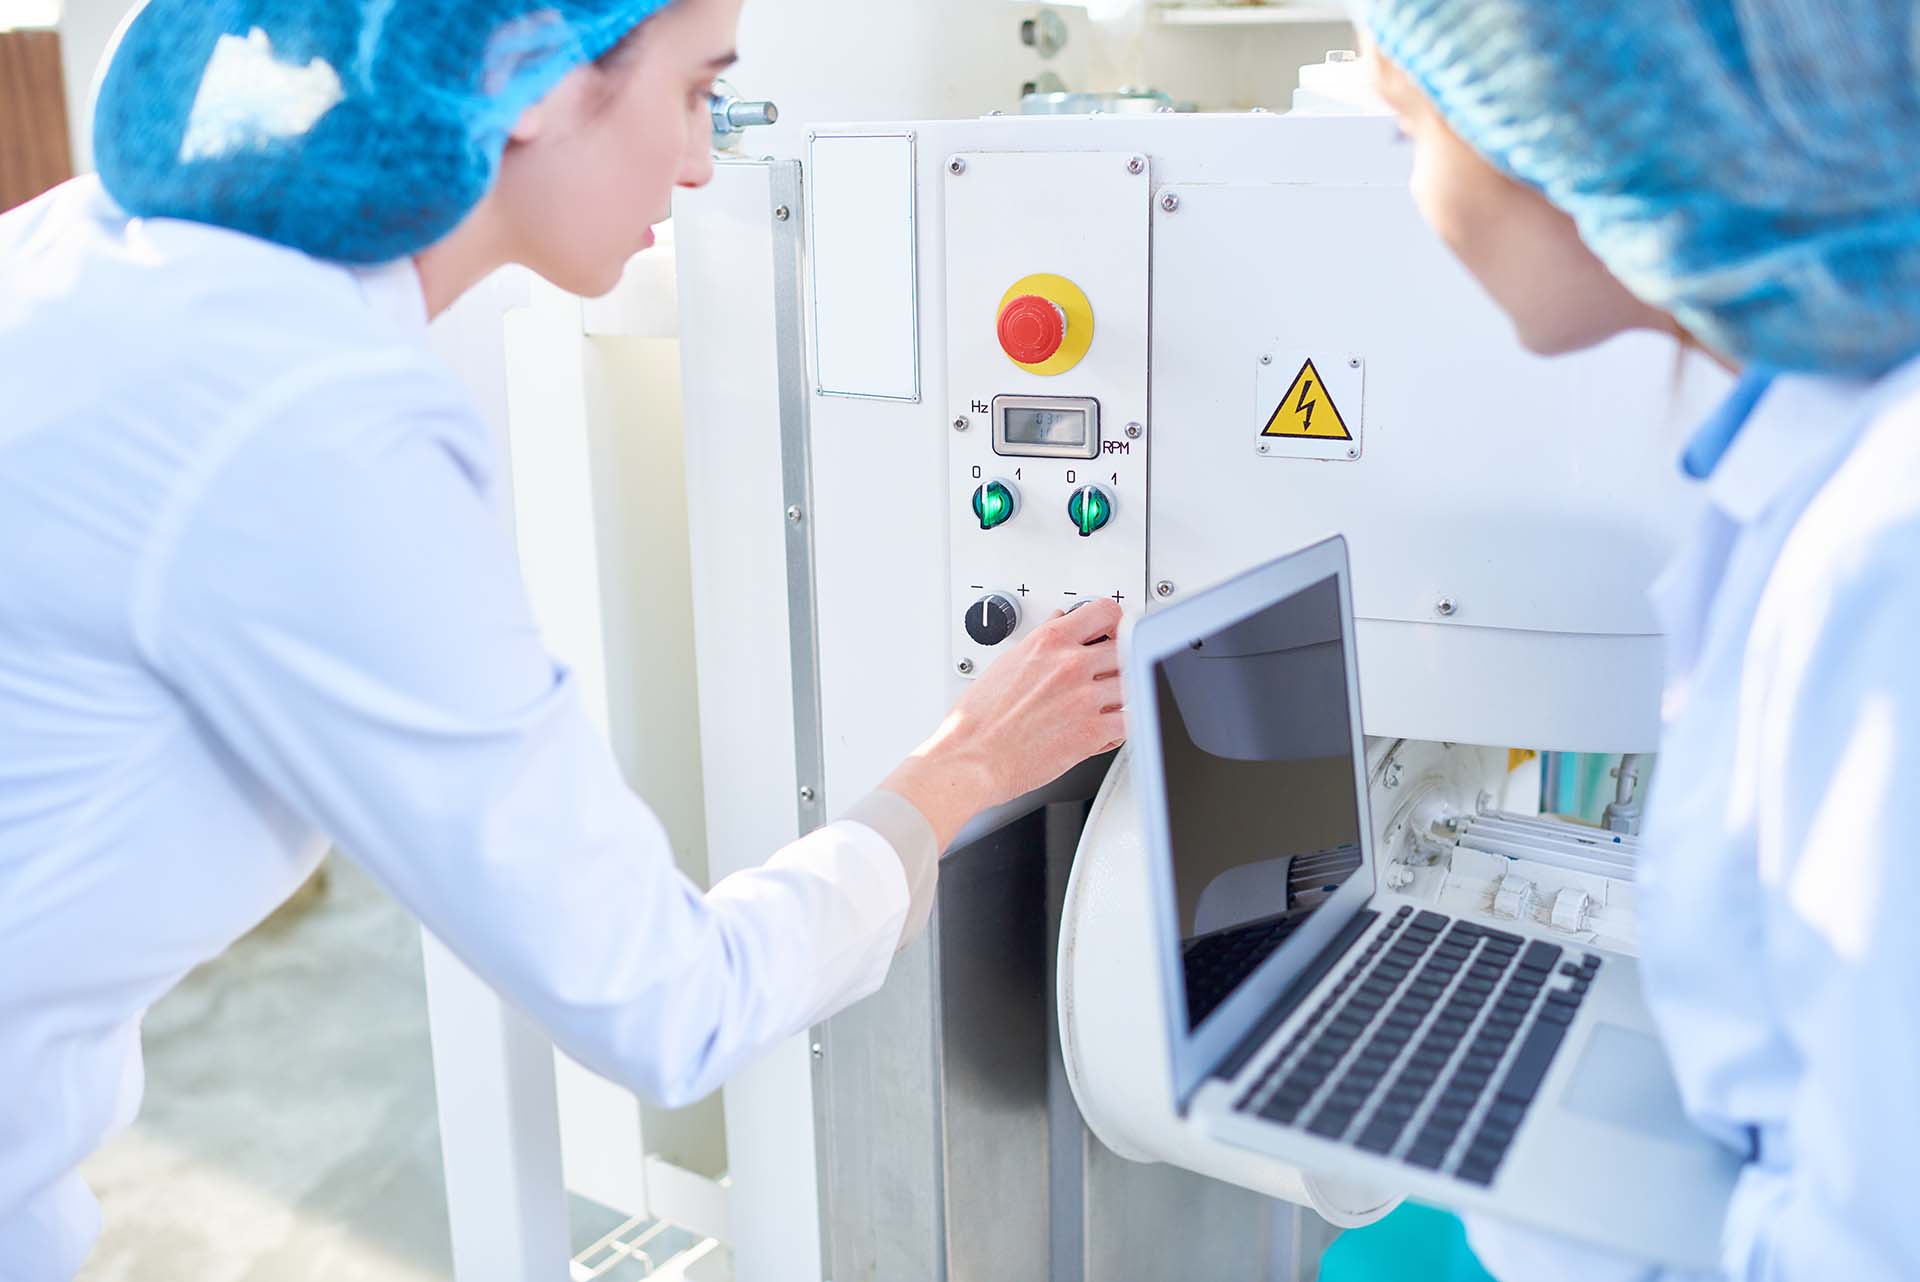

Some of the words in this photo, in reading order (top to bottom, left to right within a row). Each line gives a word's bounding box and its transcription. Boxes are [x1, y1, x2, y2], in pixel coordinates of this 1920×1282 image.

[971, 399, 989, 413] Hz
[1102, 440, 1130, 455] RPM
[1015, 467, 1021, 481] 1
[1111, 472, 1117, 486] 1
